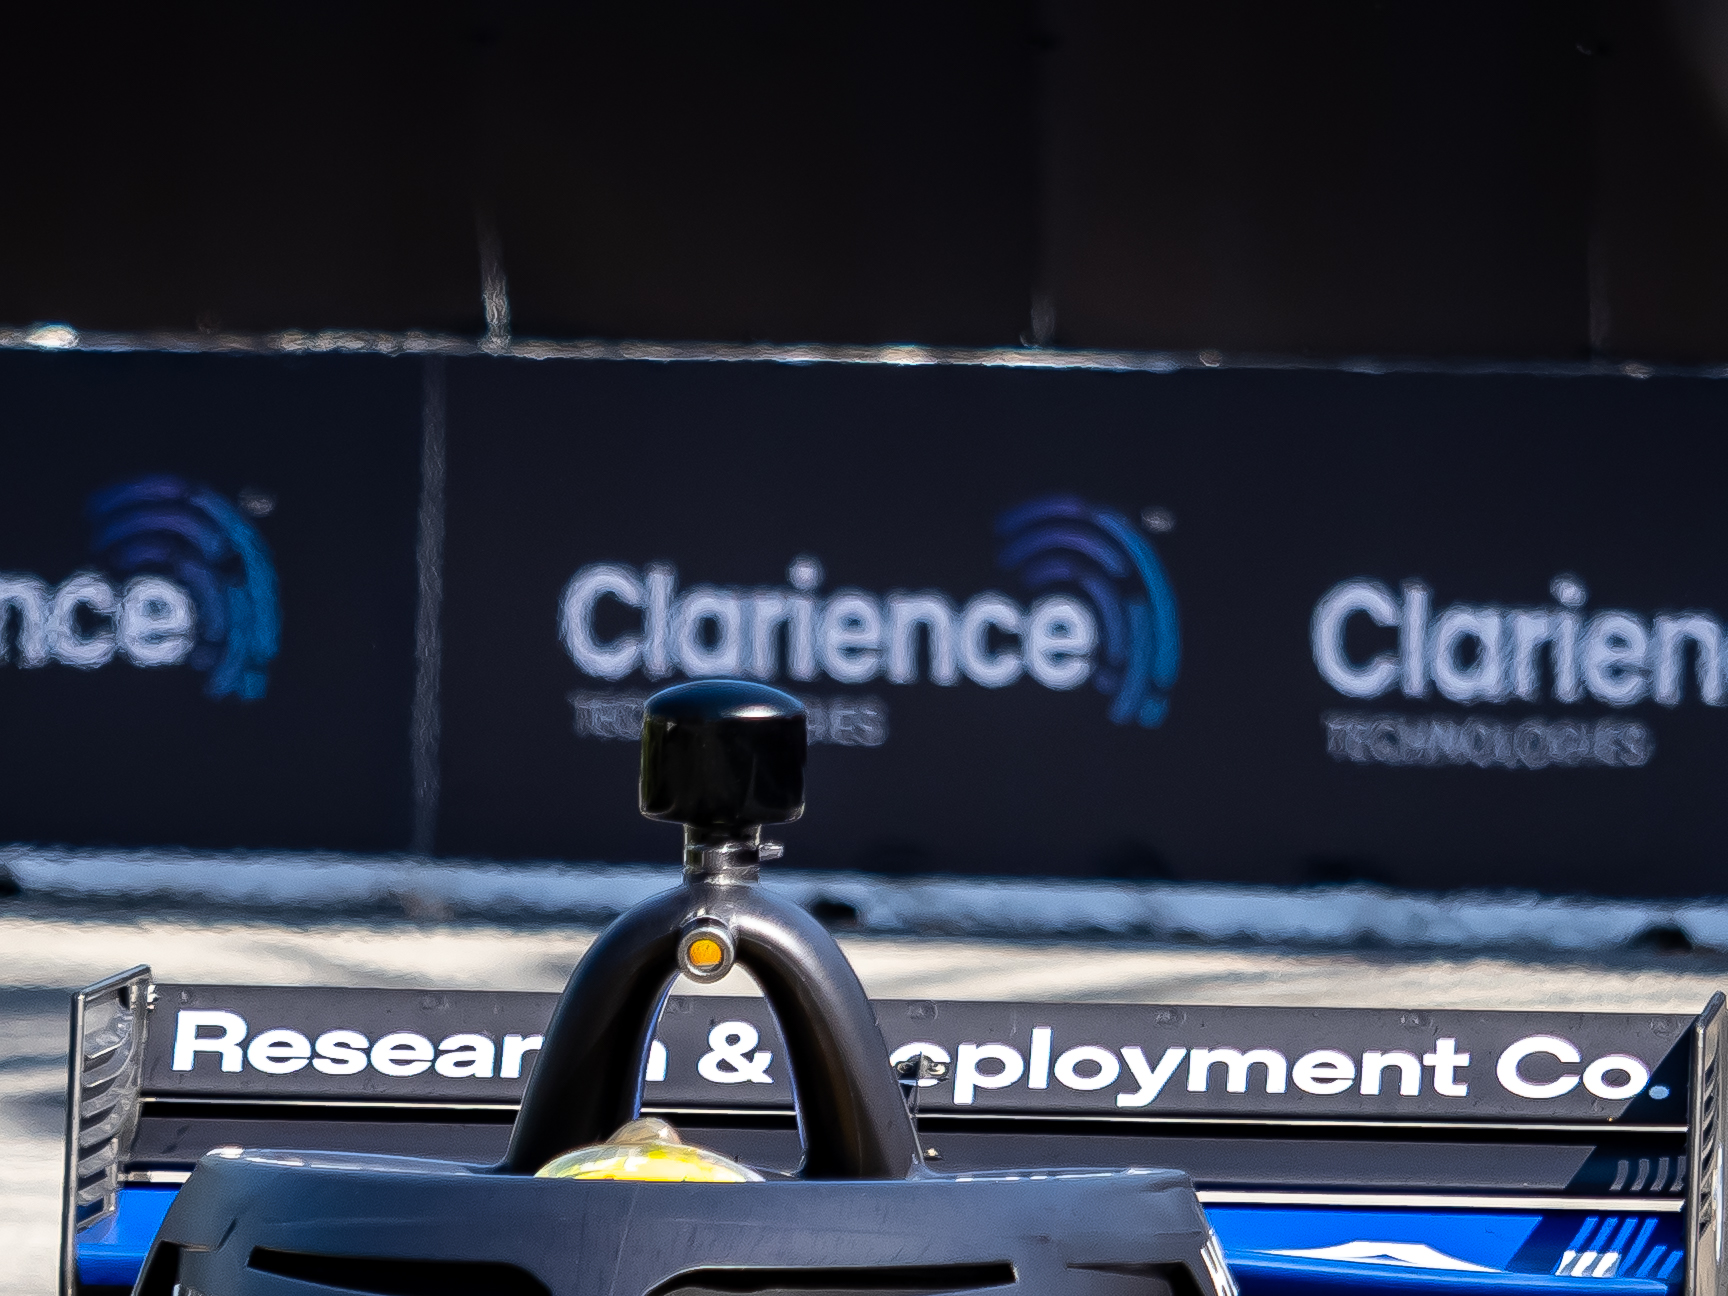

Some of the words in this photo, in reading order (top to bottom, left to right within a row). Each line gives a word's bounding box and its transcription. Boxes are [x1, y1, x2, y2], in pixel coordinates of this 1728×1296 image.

[561, 561, 1095, 688] Clarience
[171, 1009, 667, 1082] Resear
[697, 1020, 774, 1084] &
[889, 1026, 1470, 1107] eployment
[1496, 1034, 1671, 1101] Co.
